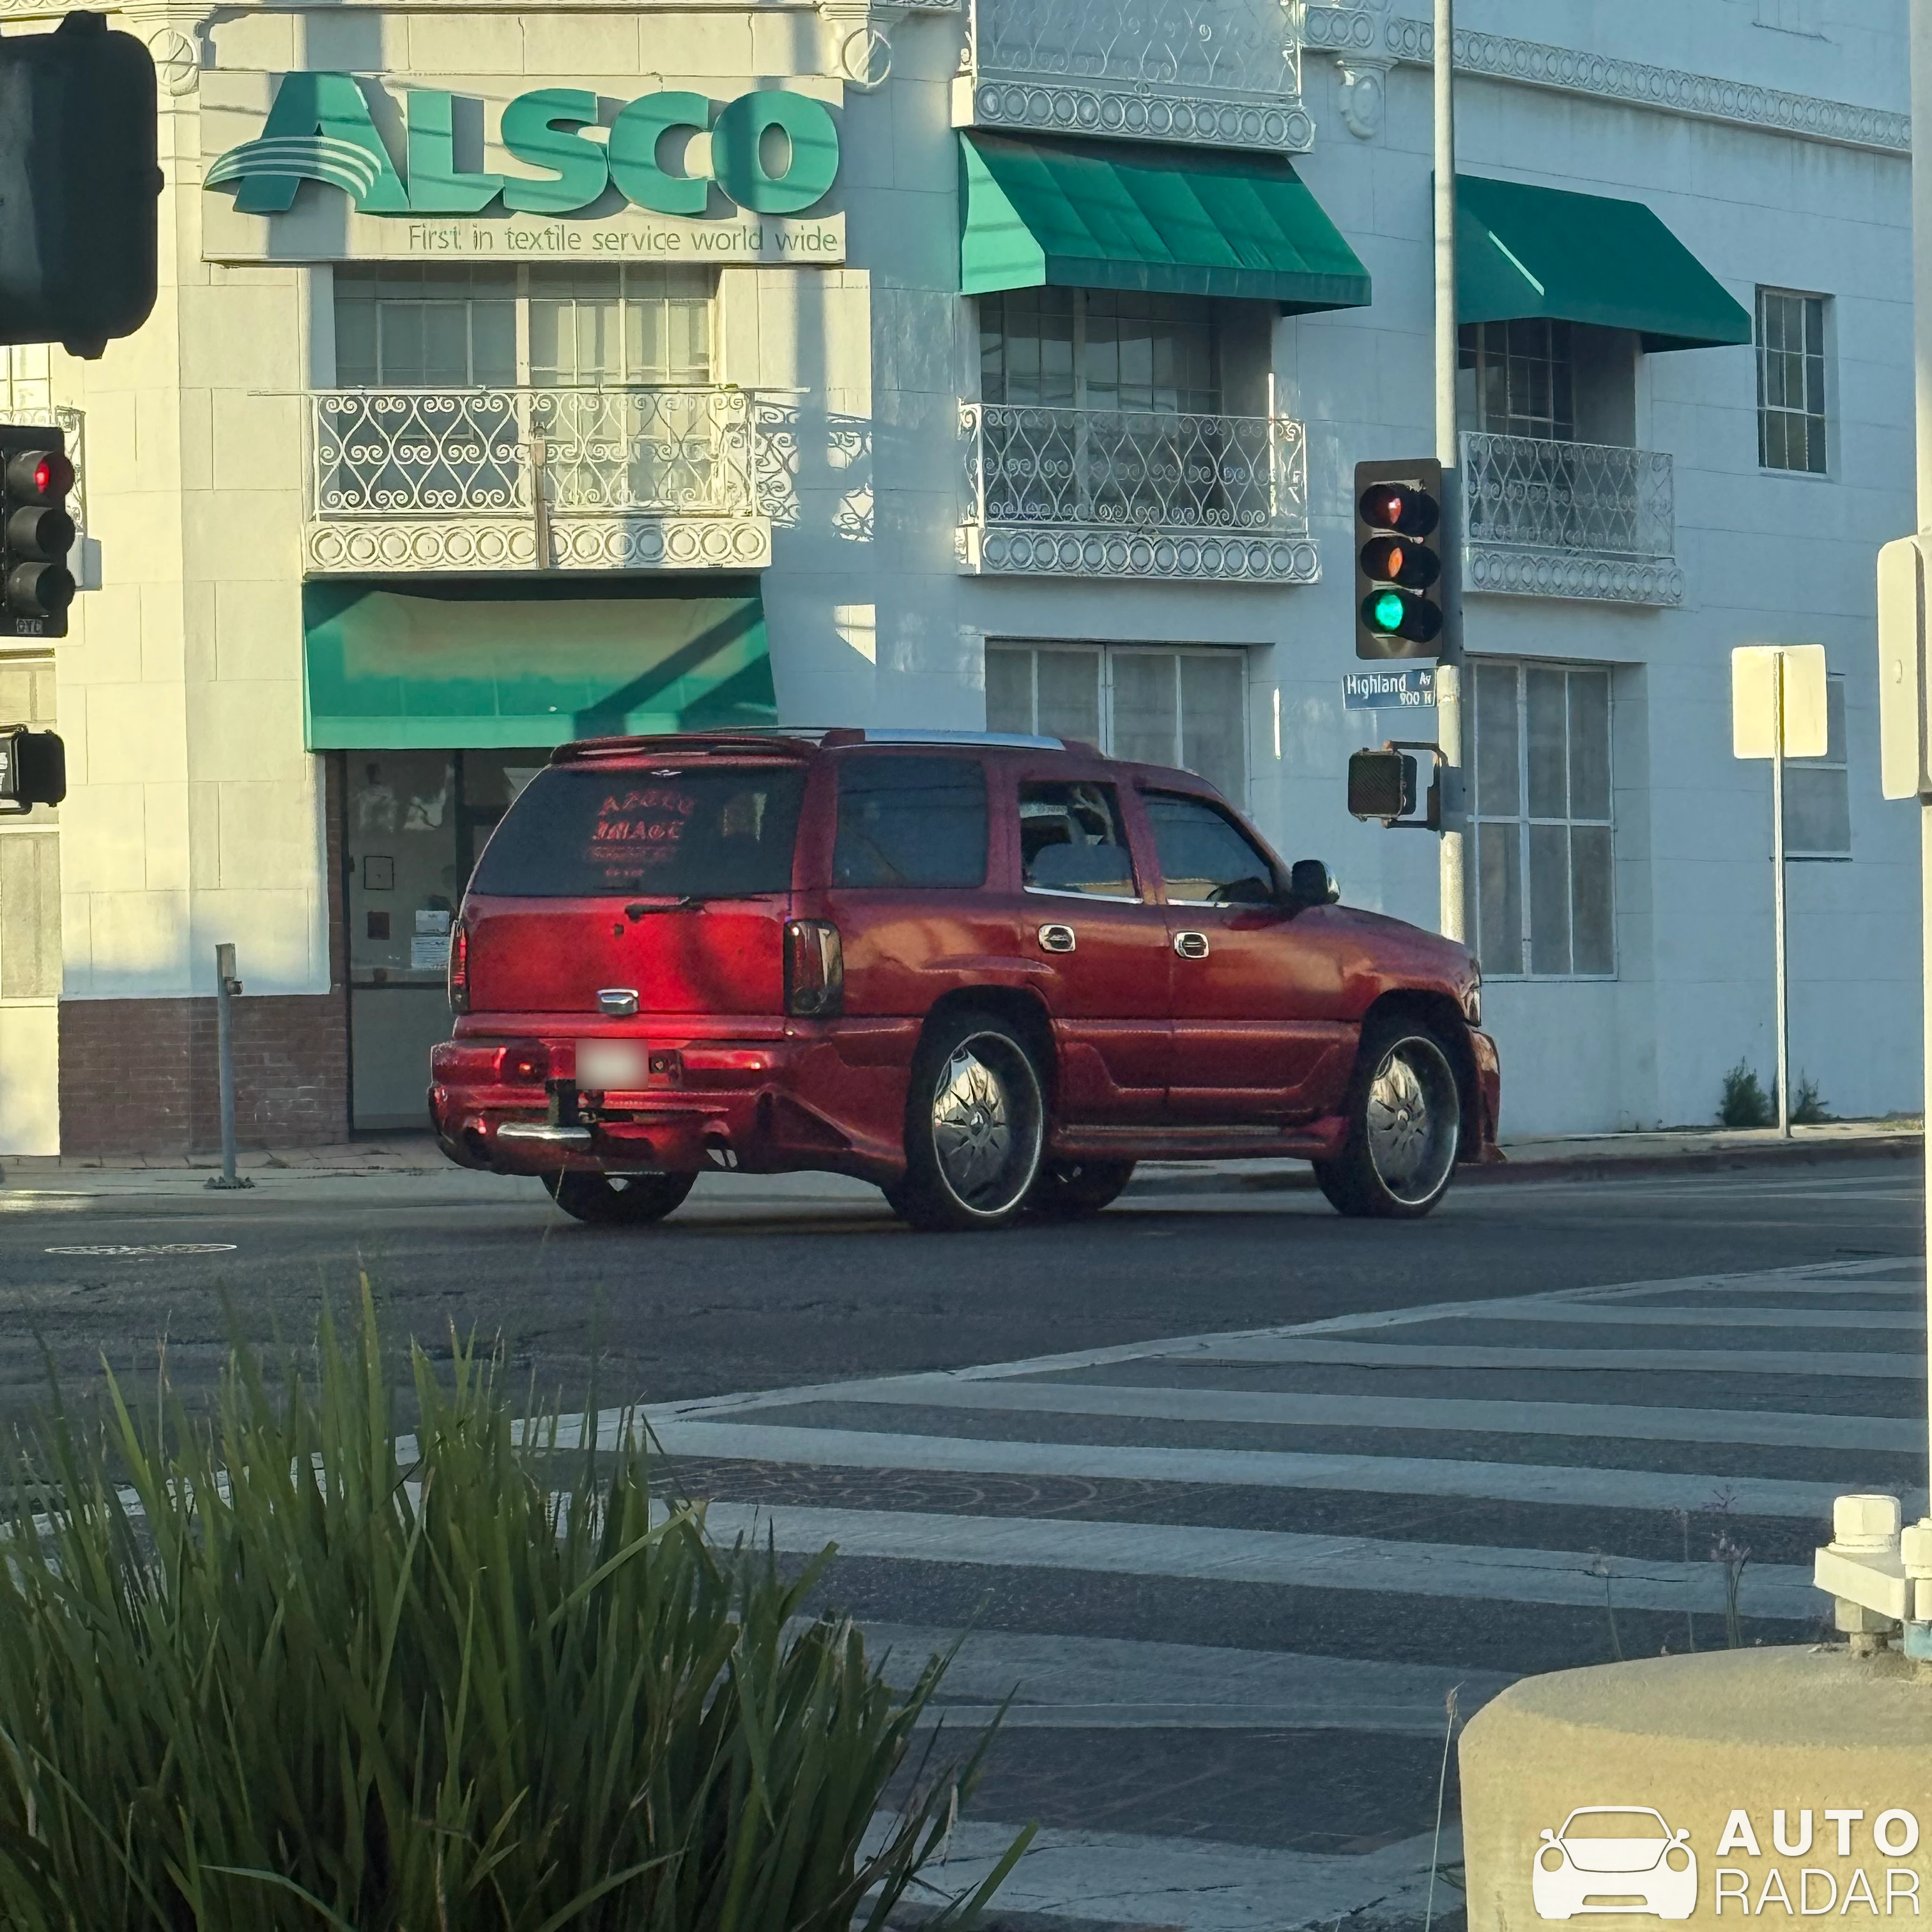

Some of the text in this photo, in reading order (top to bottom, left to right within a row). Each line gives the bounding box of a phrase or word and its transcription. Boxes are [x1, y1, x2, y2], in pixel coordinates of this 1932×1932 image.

[203, 72, 840, 215] ALSCO
[410, 223, 838, 251] First in textile service world wide
[1347, 673, 1406, 700] Highland
[1400, 691, 1420, 705] 900
